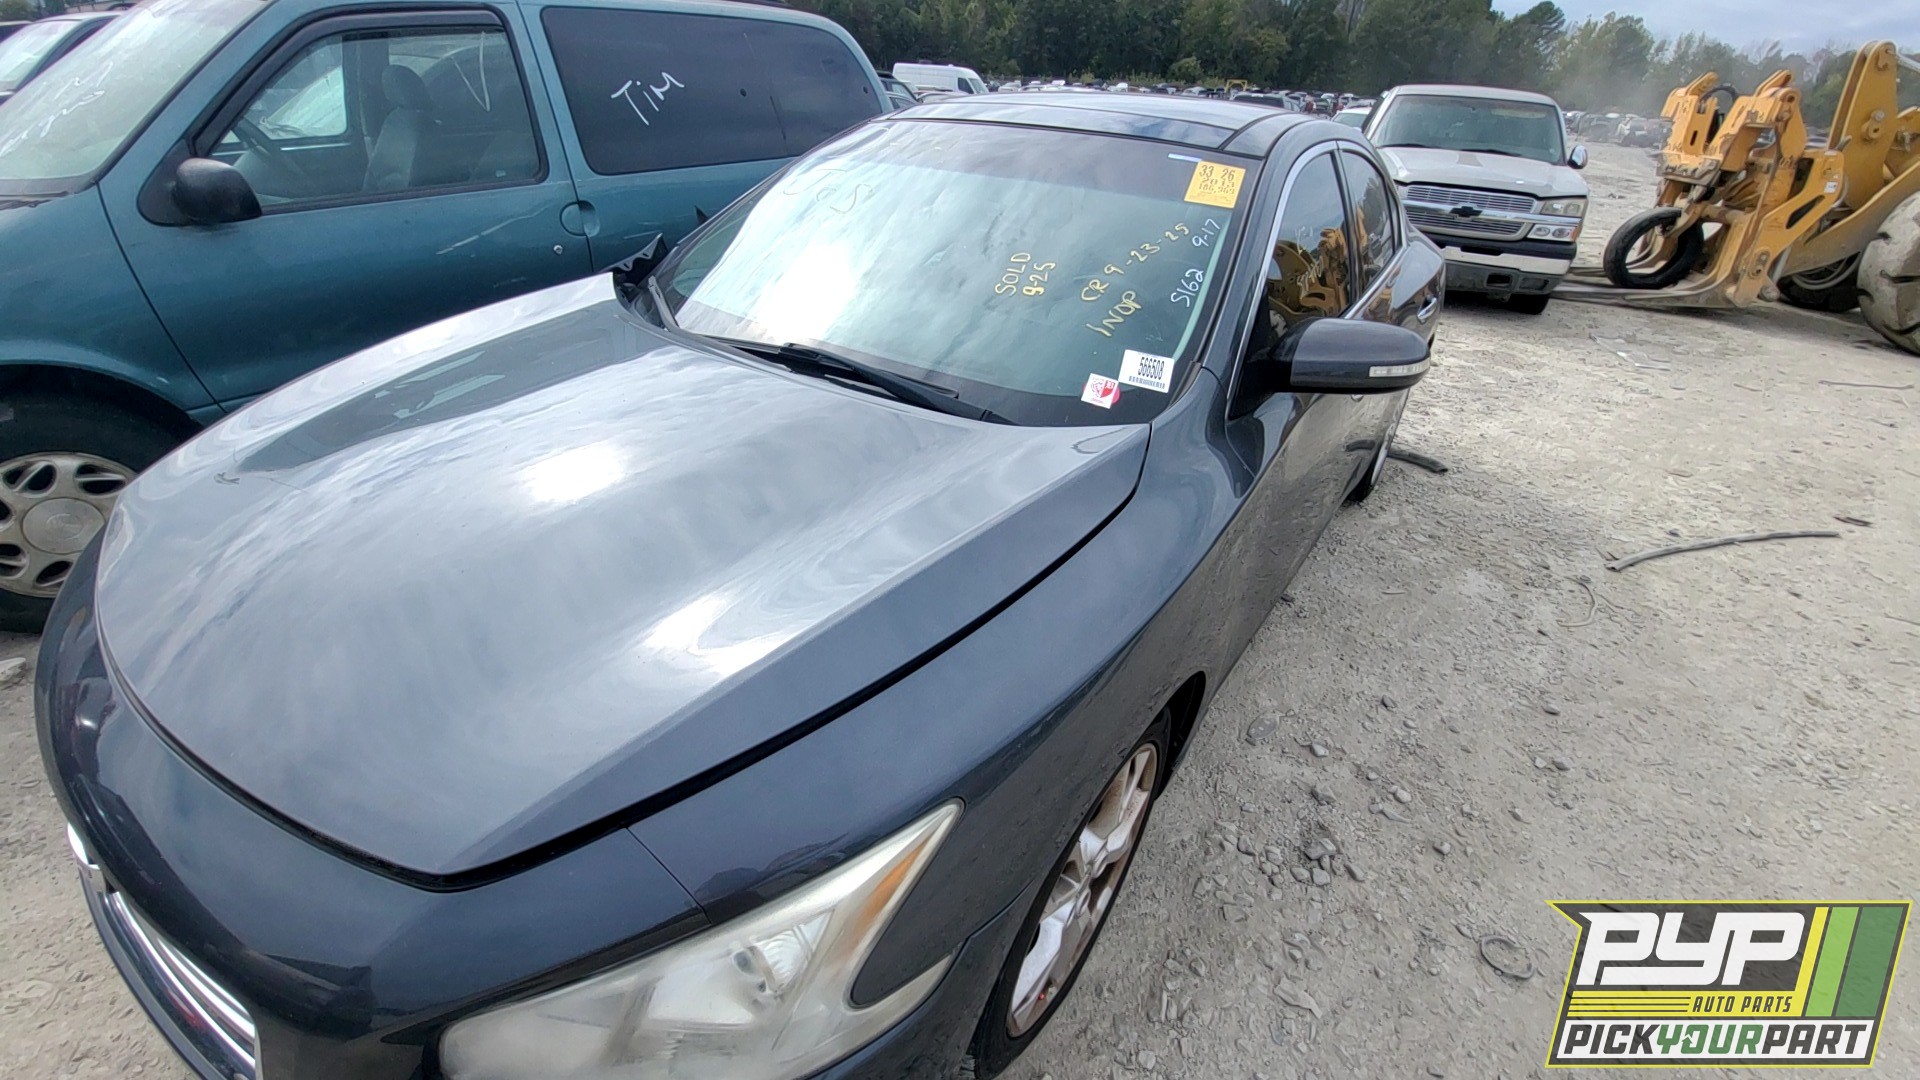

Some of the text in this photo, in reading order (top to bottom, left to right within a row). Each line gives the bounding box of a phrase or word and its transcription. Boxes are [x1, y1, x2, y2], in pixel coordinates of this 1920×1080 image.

[1199, 164, 1236, 181] 33 26
[1192, 218, 1221, 247] 9-17
[995, 252, 1031, 297] SOLD
[1081, 279, 1109, 301] CR
[1086, 290, 1142, 337] INOP
[1137, 356, 1165, 380] 566508
